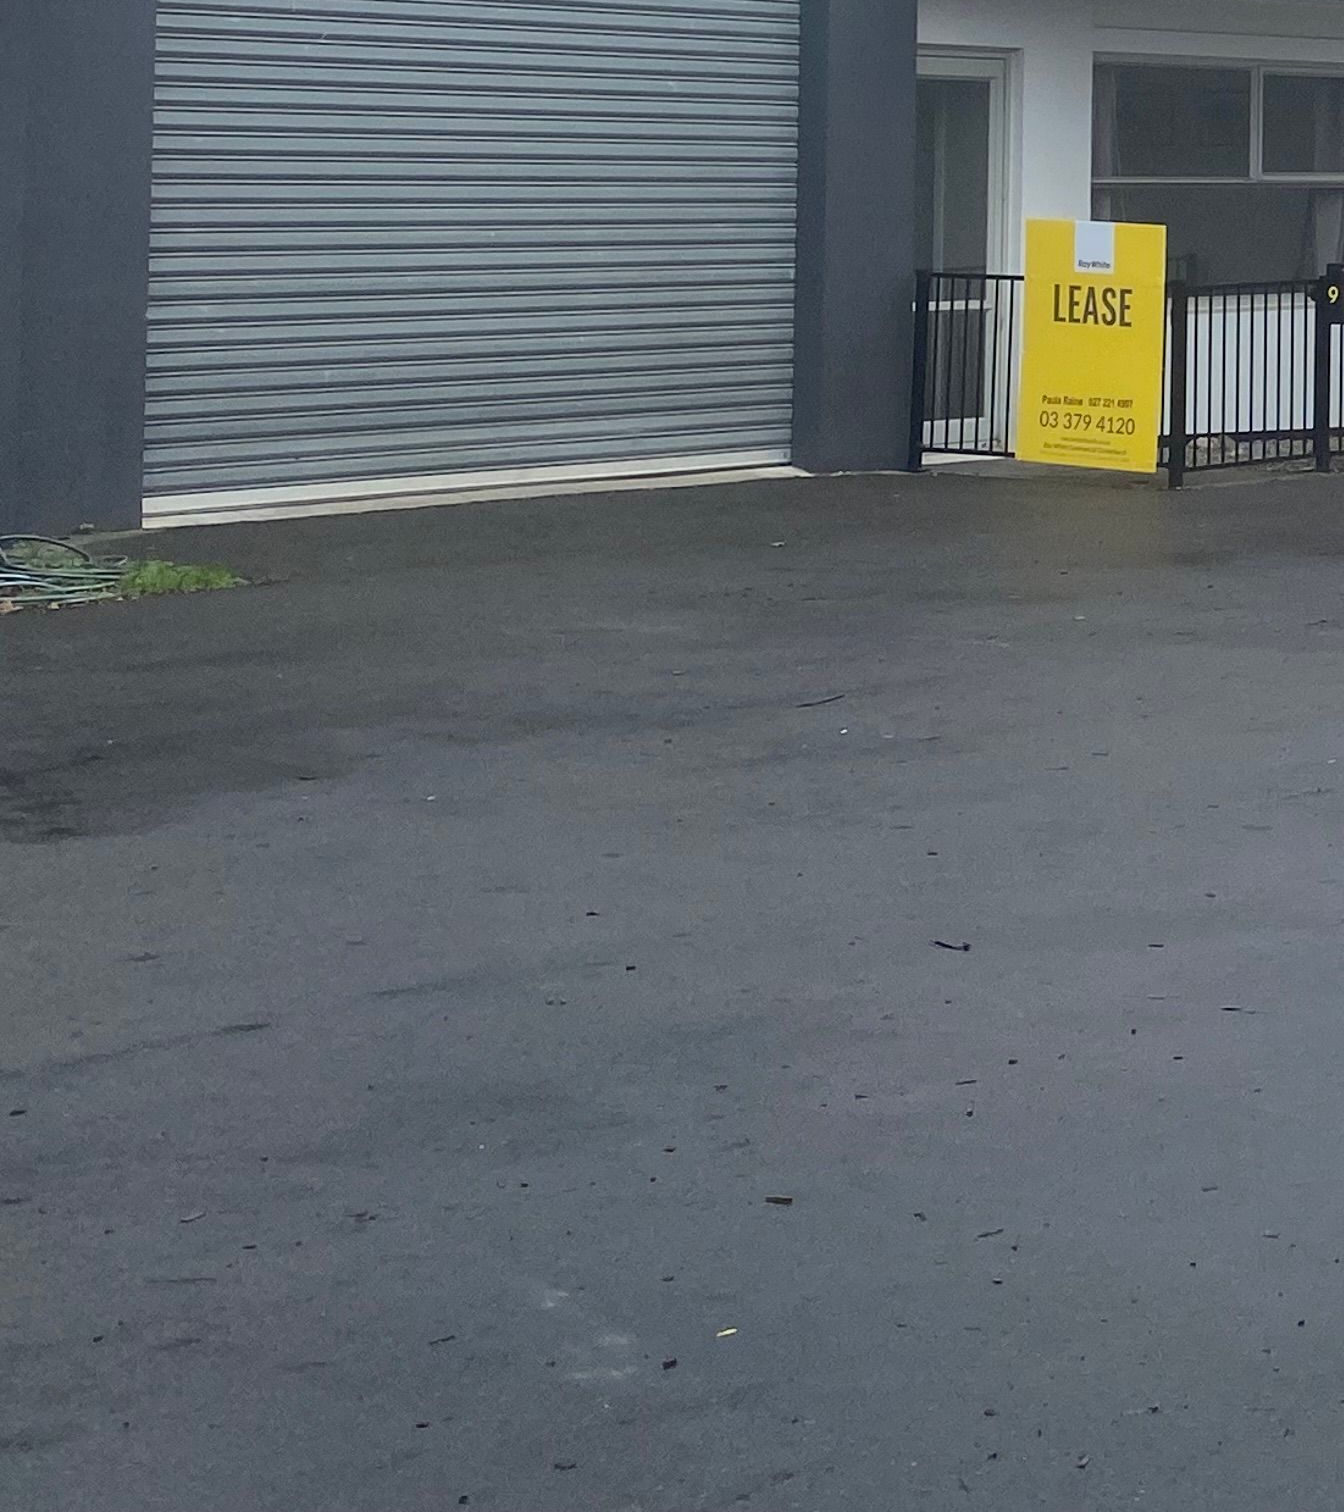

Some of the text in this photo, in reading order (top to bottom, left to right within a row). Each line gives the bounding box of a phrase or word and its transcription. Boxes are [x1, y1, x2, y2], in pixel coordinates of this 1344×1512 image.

[1053, 284, 1133, 327] LEASE
[1328, 286, 1339, 303] 9
[1039, 410, 1136, 435] 03 379 4120
